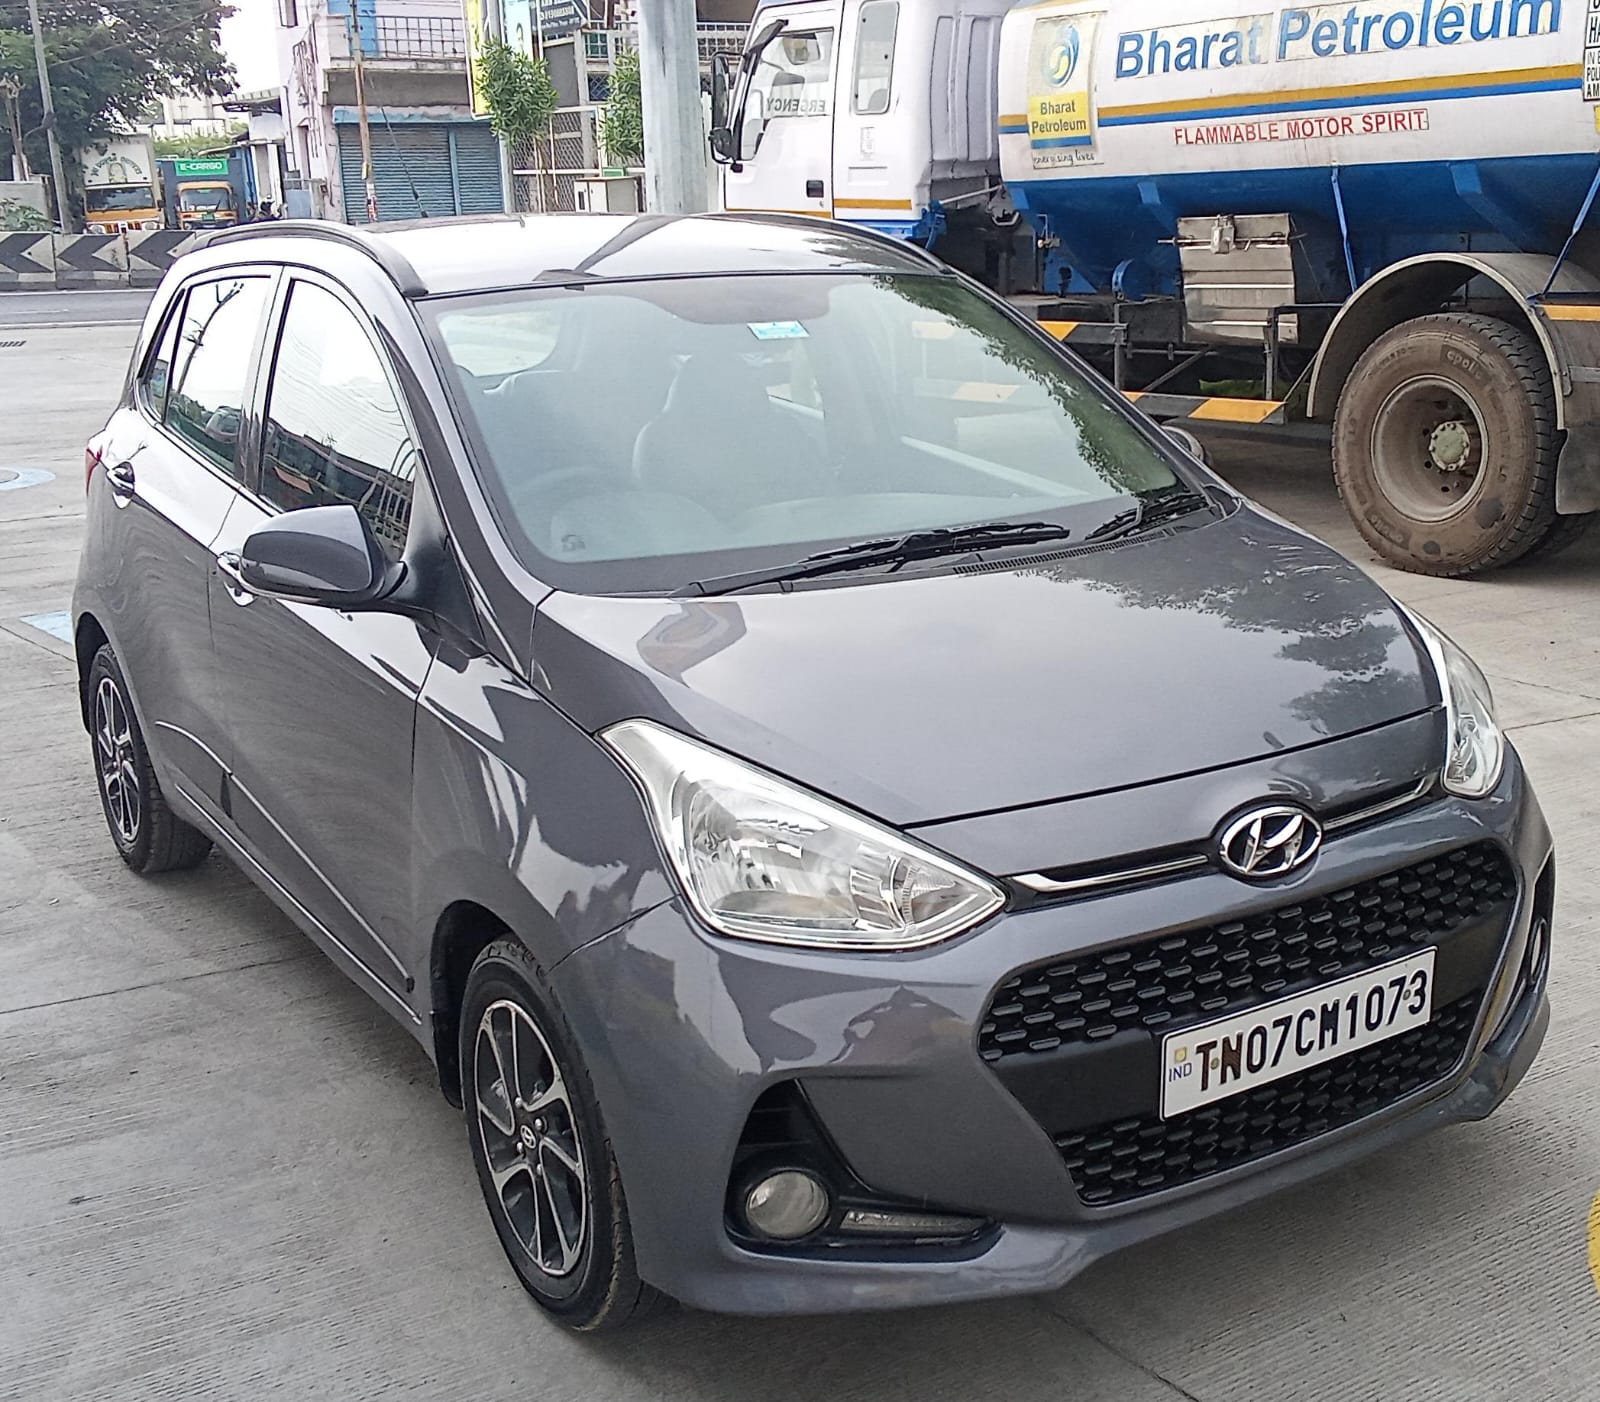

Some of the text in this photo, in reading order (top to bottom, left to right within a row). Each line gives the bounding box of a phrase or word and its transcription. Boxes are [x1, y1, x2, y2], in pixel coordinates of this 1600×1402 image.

[1115, 0, 1562, 79] Bharat Petroleum
[1040, 100, 1076, 116] Bharat
[1031, 119, 1087, 134] Petroleum
[1174, 110, 1425, 145] FLAMMABLE MOTOR SPIRIT
[1195, 969, 1428, 1092] TN07CM1073
[1168, 1062, 1193, 1083] IND
